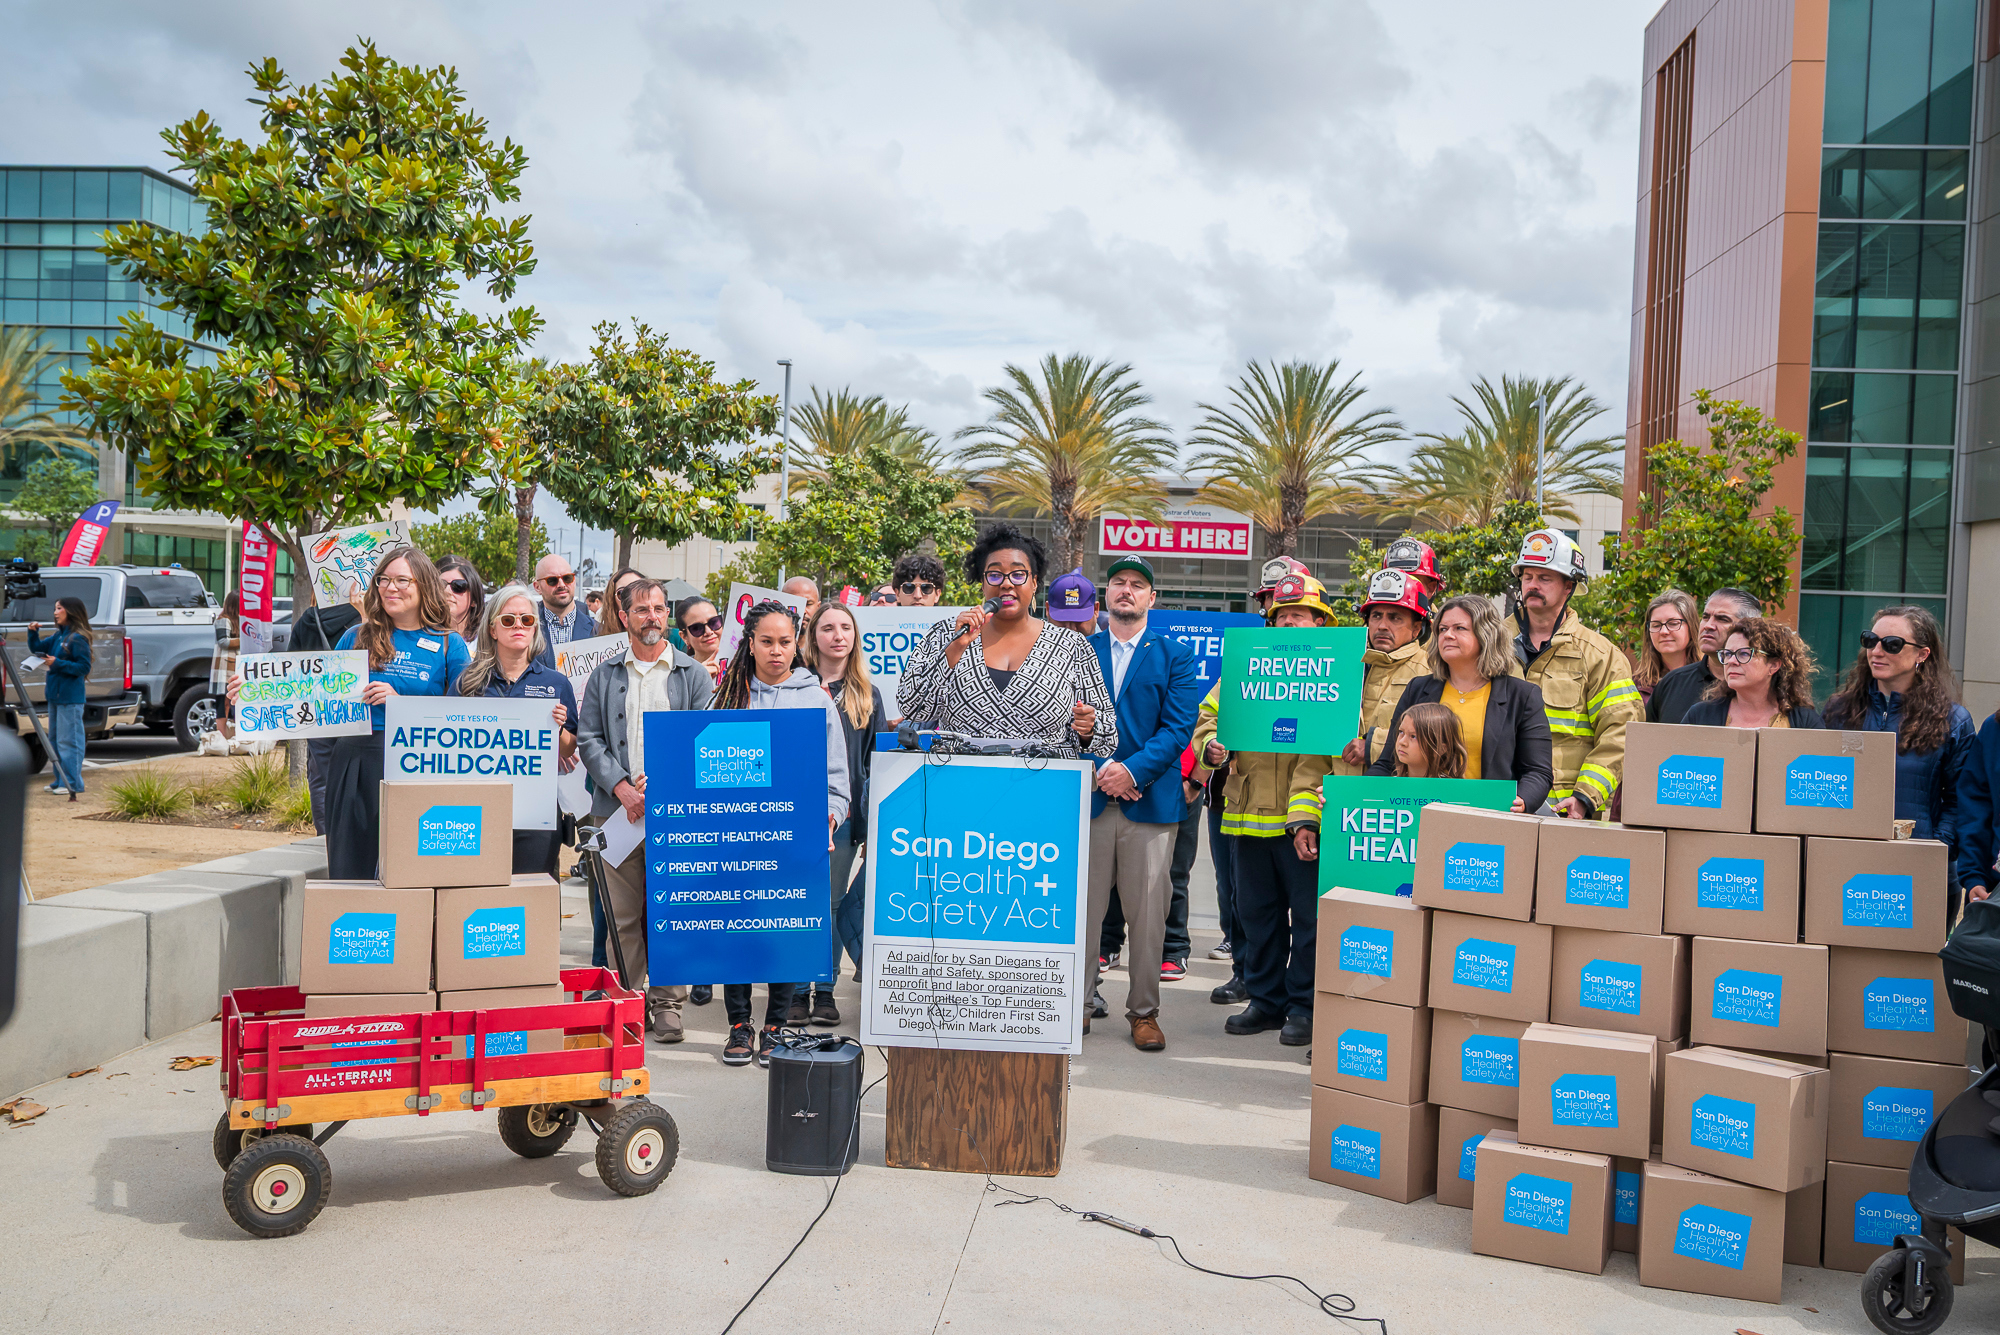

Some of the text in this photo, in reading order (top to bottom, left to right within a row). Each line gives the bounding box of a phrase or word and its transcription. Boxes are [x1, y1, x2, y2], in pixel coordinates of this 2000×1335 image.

[96, 505, 111, 521] P
[1106, 525, 1246, 550] VOTE HERE
[244, 659, 324, 680] HELP US
[1248, 658, 1335, 677] PREVENT
[240, 672, 358, 702] GROW UP
[1240, 682, 1340, 702] WILDFIRES
[240, 704, 296, 732] SAFE
[446, 714, 466, 722] VOTE
[390, 726, 552, 750] AFFORDABLE
[700, 746, 764, 760] San Diego
[400, 752, 542, 776] CHILDCARE
[710, 759, 752, 770] Health
[700, 771, 766, 785] Safety Act
[1662, 769, 1716, 783] San Diego
[1413, 798, 1428, 806] YES
[1662, 789, 1717, 802] Safety Act
[668, 802, 794, 814] FIX THE SEWAGE CRISIS
[422, 820, 475, 832] San Diego
[1341, 808, 1414, 834] KEEP
[668, 831, 792, 844] PROTECT HEALTHCARE
[422, 840, 476, 851] Safety Act
[890, 828, 1060, 870] San Diego
[669, 860, 778, 872] PREVENT WILDFIRES
[916, 862, 1026, 895] Health
[670, 889, 806, 902] AFFORDABLE CHILDCARE
[1846, 889, 1906, 902] San Diego
[888, 892, 1061, 934] Safety Act
[1848, 909, 1907, 922] Safety Act
[468, 922, 520, 934] San Diego
[670, 917, 822, 930] TAXPAYER ACCOUNTABILITY
[468, 941, 521, 954] Safety Act
[888, 950, 1060, 968] Ad paid for by San Diegans for
[882, 964, 1064, 984] Health and Safety, sponsored by
[879, 978, 928, 990] nonprofit
[932, 980, 952, 990] and
[956, 980, 984, 992] labor
[889, 991, 1056, 1009] Ad Committee's Top Funders:
[884, 1004, 1060, 1022] Melvyn Katz, Children First San
[294, 1022, 404, 1038] RADIO FLYER
[939, 1020, 964, 1031] Irwin
[968, 1022, 996, 1032] Mark
[1000, 1024, 1044, 1035] Jacobs.
[306, 1069, 392, 1083] ALL-TERRAIN
[351, 1077, 392, 1085] WAGON
[1510, 1187, 1564, 1207] San Diego
[1683, 1218, 1742, 1241] San Diego
[1680, 1238, 1740, 1262] Safety Act
